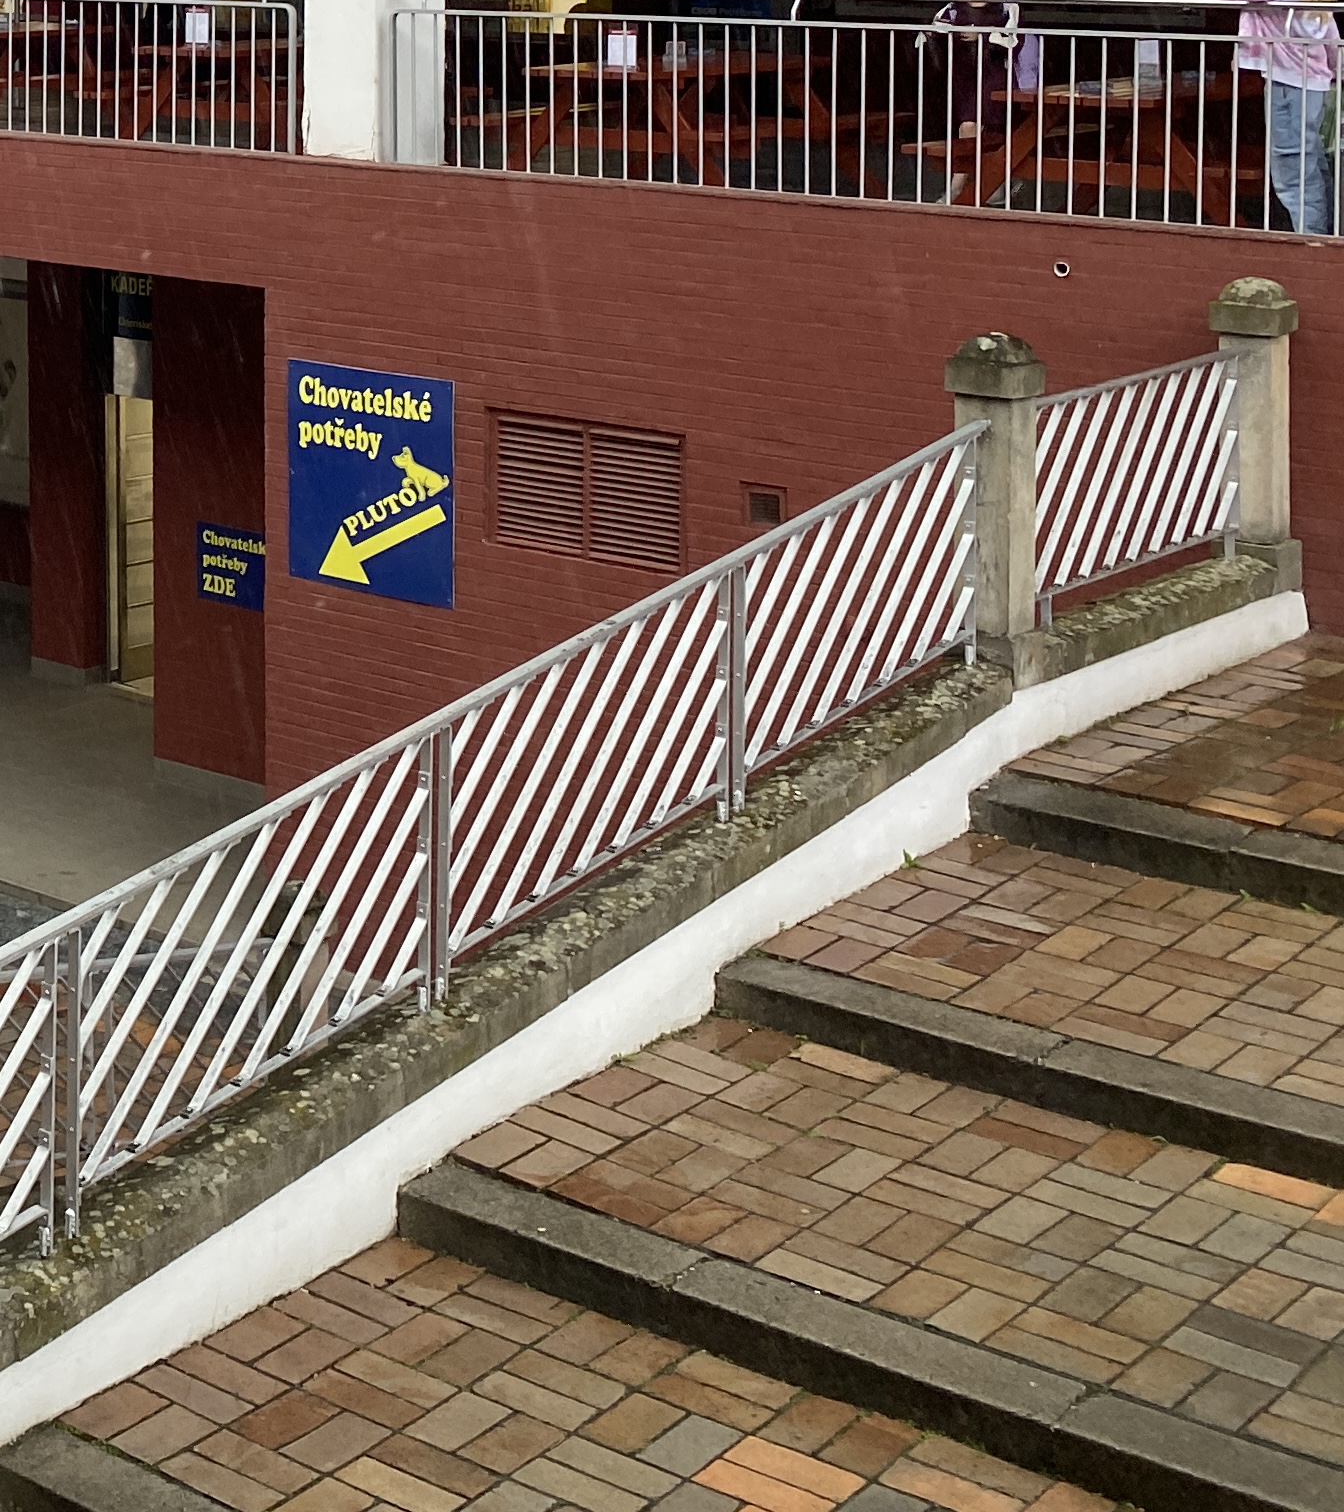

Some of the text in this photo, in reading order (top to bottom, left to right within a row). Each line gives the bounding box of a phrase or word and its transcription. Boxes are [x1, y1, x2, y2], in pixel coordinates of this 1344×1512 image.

[111, 275, 152, 296] KADEŘ
[299, 375, 432, 422] Chovatelské
[298, 417, 382, 460] potřeby
[343, 487, 417, 536] PLUTO
[203, 529, 265, 555] Chovatelsk
[203, 554, 248, 575] potřeby
[203, 573, 236, 597] ZDE
